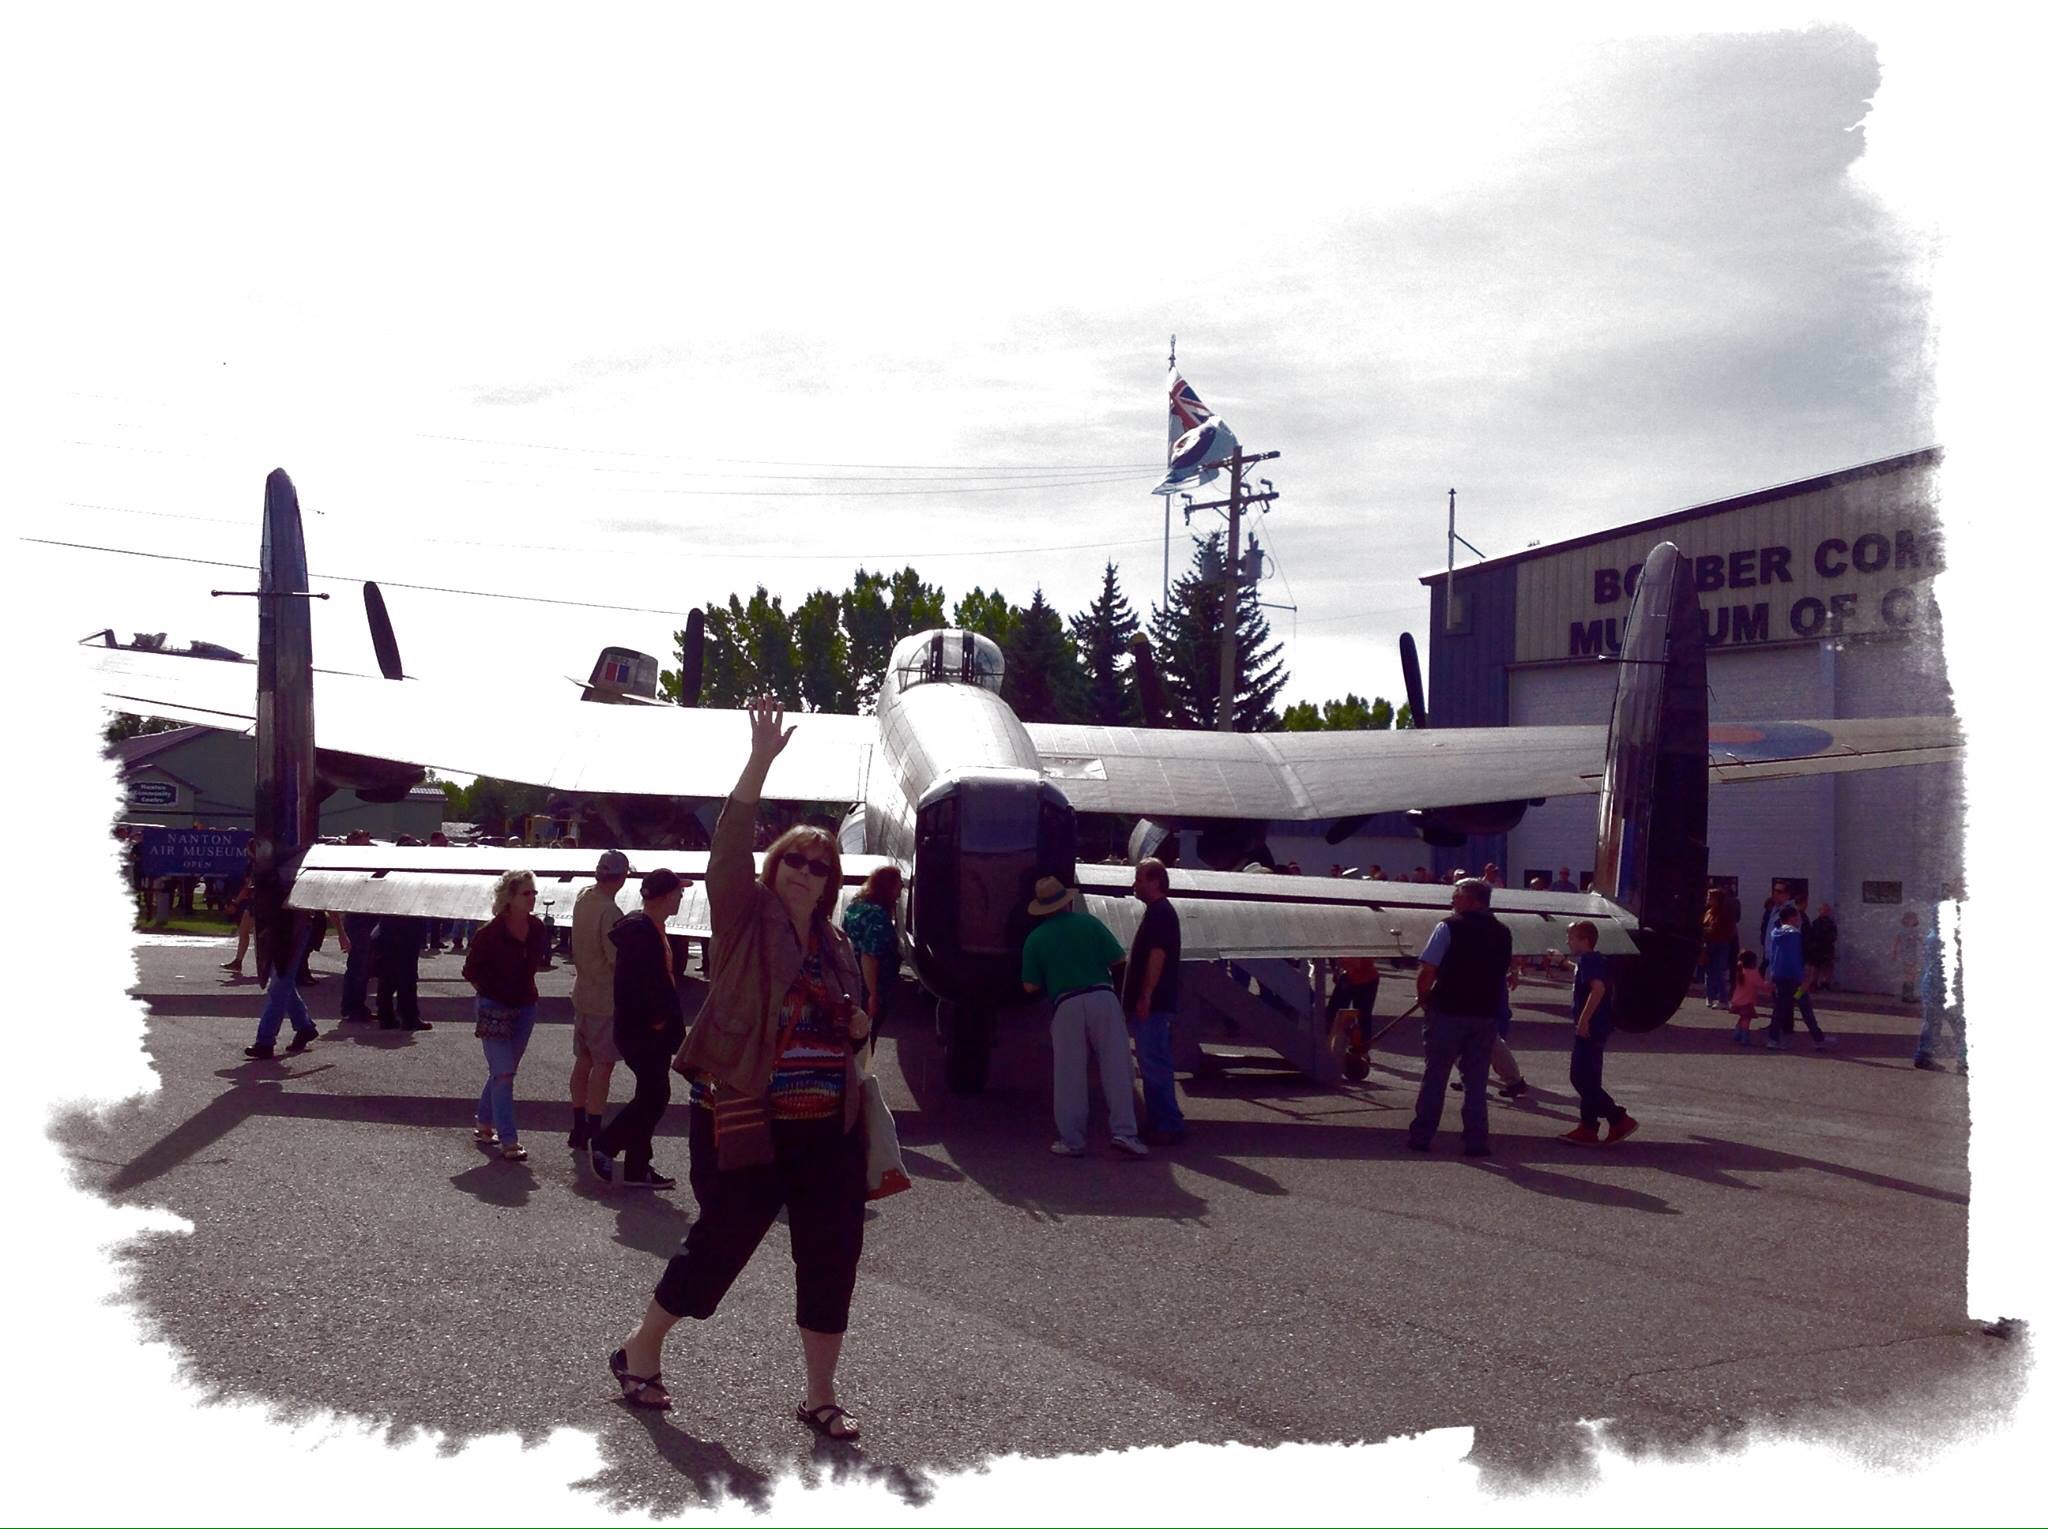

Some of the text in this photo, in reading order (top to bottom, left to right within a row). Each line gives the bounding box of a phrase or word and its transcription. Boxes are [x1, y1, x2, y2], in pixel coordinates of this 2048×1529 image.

[1594, 546, 1793, 604] BBER
[1570, 603, 1769, 655] MUUM
[1790, 593, 1857, 636] OF
[150, 846, 247, 857] AIR MUSEUM
[167, 833, 232, 845] NANTON
